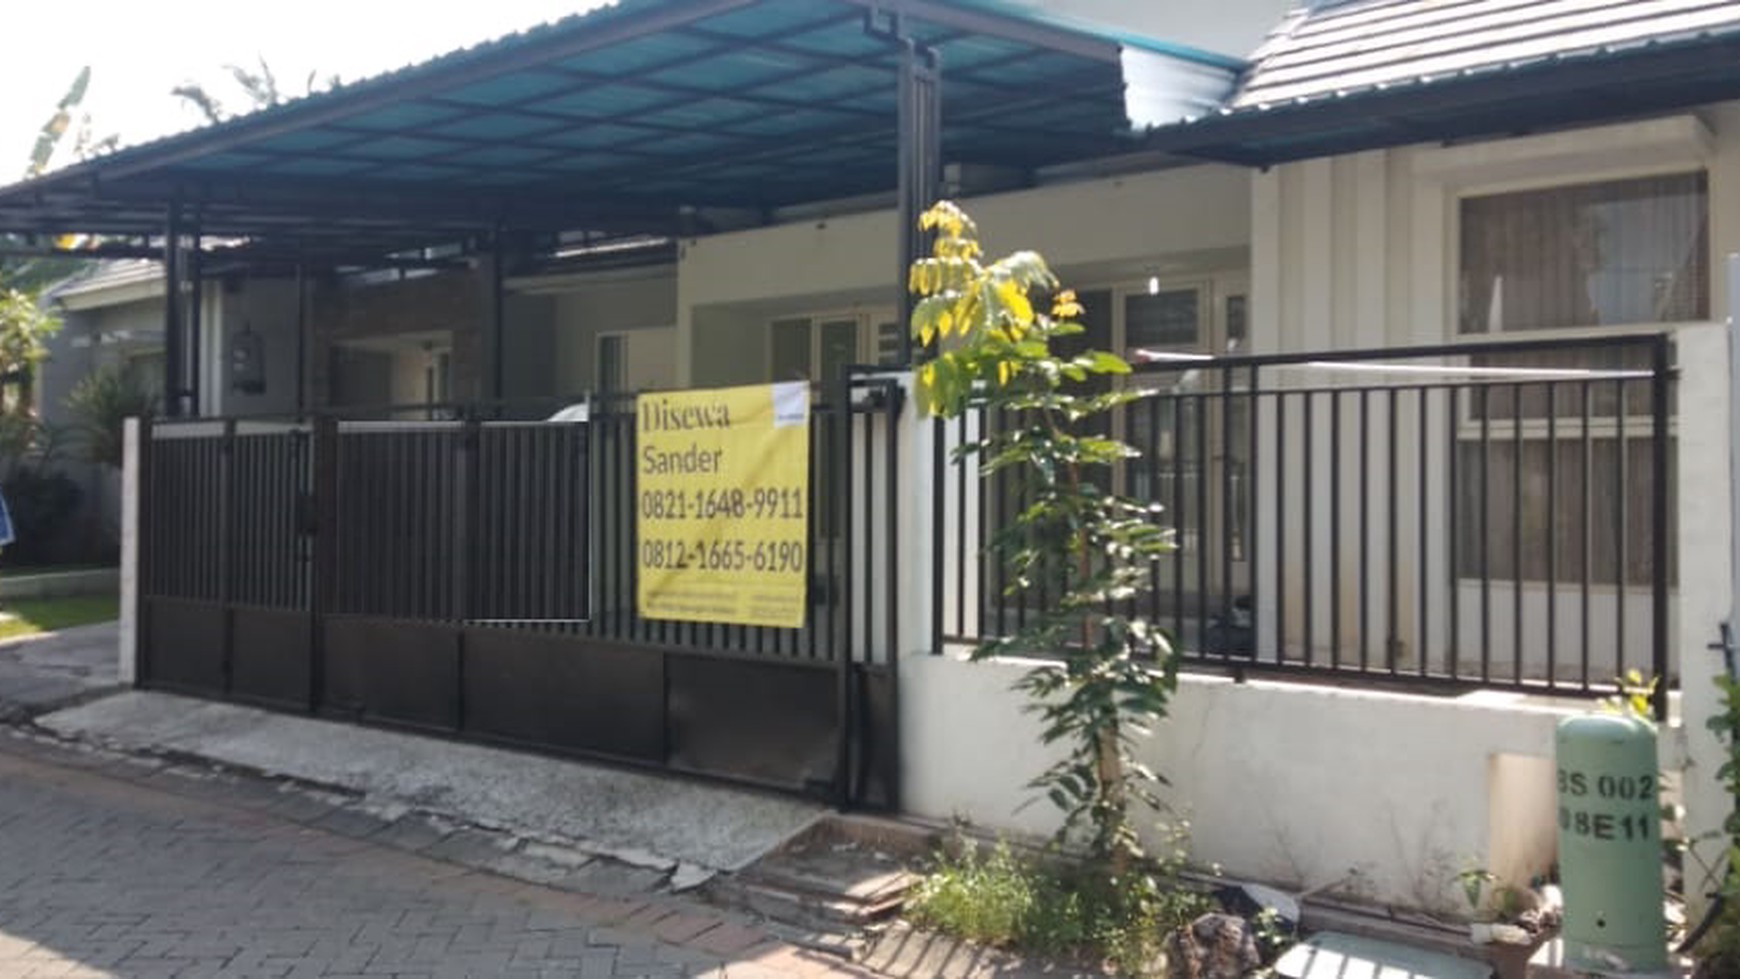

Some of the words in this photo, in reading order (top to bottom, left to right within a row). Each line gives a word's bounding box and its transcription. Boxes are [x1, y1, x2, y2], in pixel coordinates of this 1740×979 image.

[643, 399, 729, 430] Disewa
[643, 443, 722, 474] Sander
[642, 488, 803, 518] 0821-1648-9911
[642, 538, 803, 572] 0812-1665-6190
[1598, 775, 1653, 800] 002
